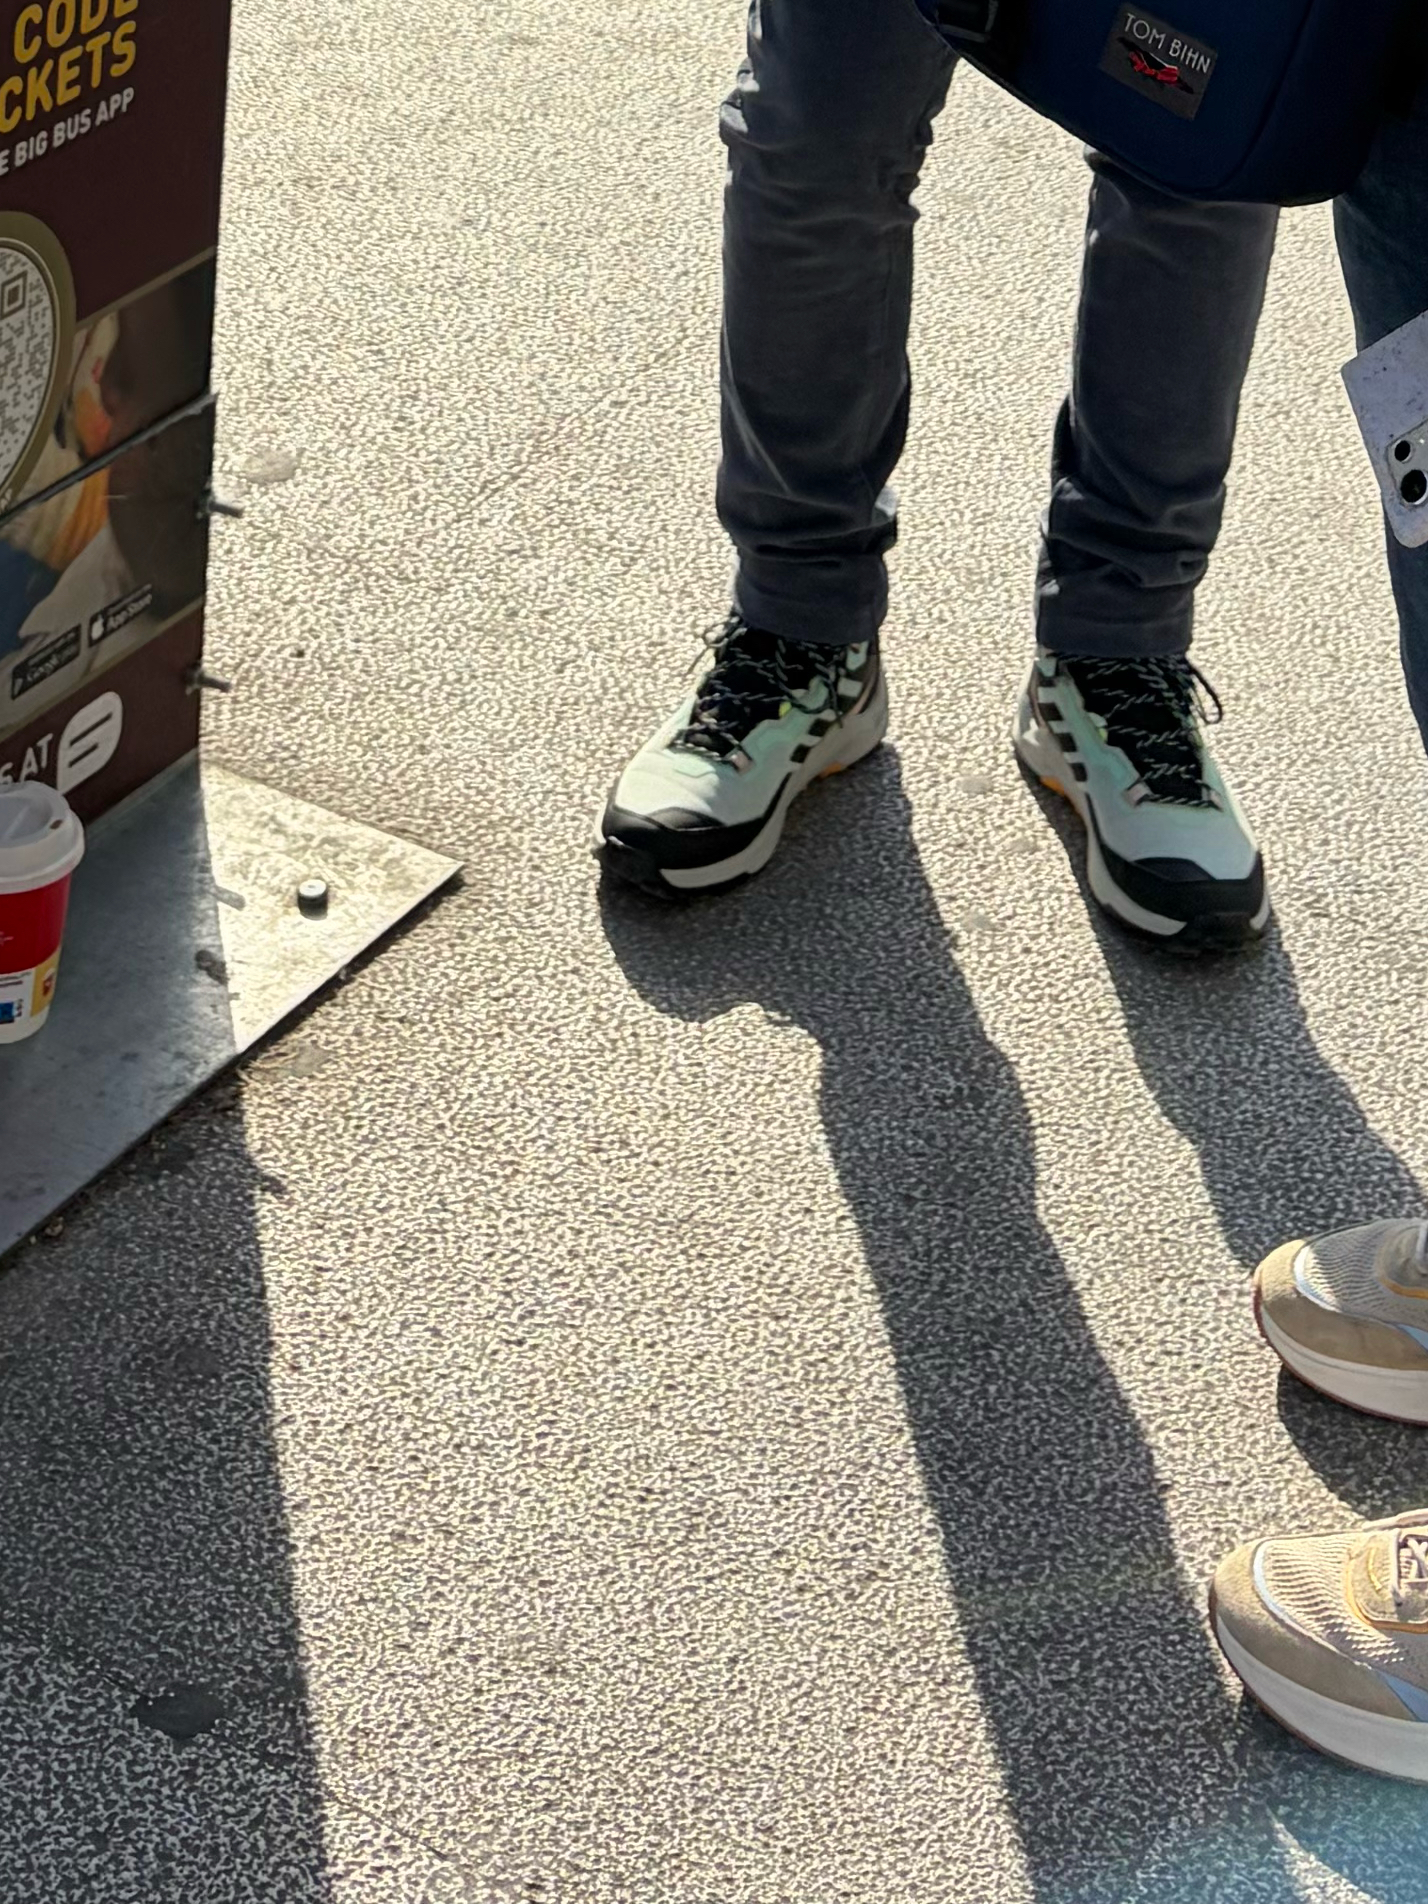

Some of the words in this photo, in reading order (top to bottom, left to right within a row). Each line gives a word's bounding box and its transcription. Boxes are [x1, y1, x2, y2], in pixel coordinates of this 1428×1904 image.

[1124, 12, 1167, 50] TOM
[1168, 38, 1211, 74] BIHN
[14, 130, 48, 168] BIG
[52, 108, 92, 149] BUS
[95, 86, 135, 127] APP
[20, 733, 54, 784] AT
